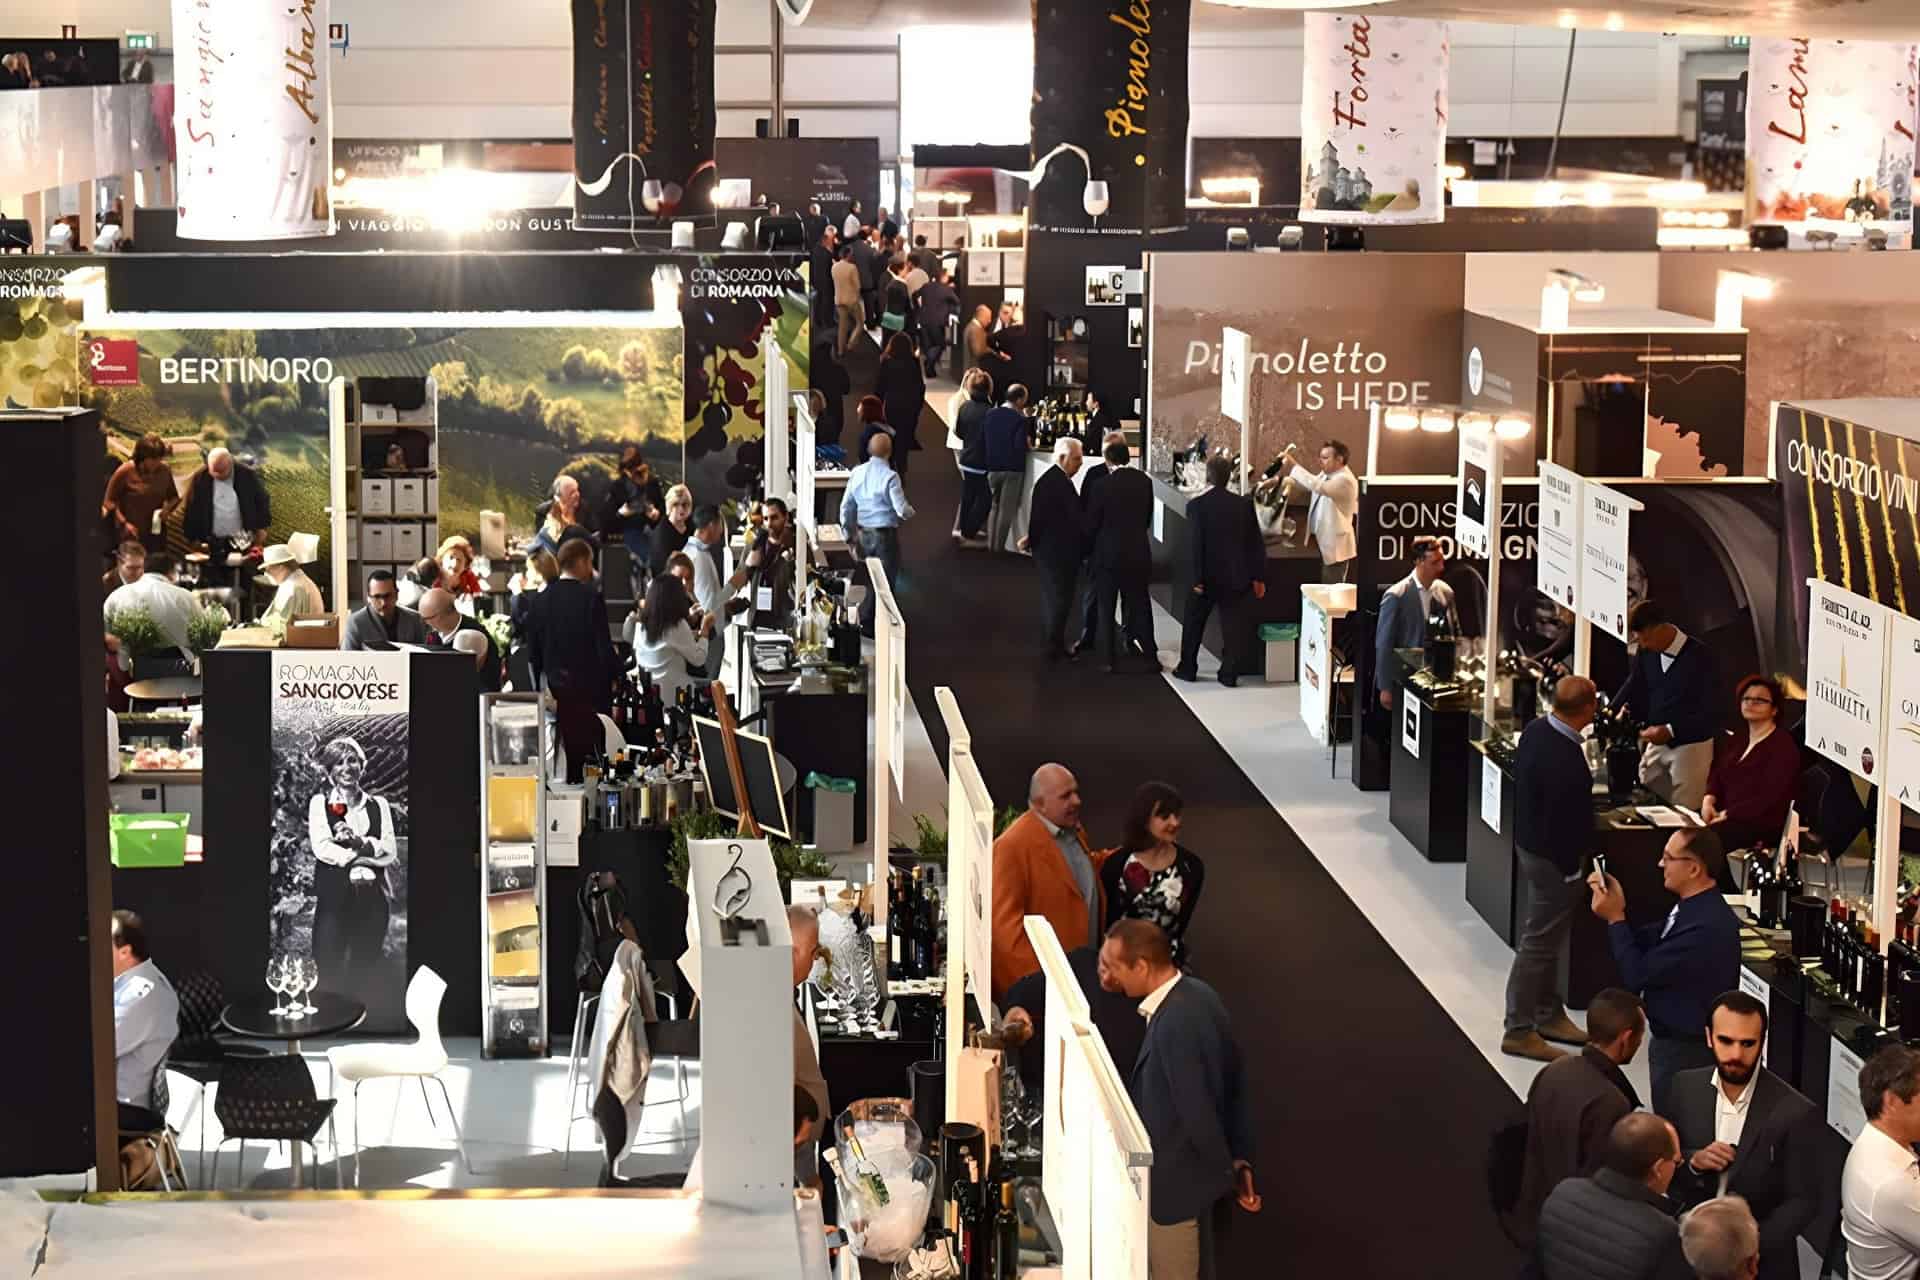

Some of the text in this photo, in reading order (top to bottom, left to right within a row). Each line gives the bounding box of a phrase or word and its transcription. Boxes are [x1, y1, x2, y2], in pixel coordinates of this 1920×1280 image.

[708, 284, 785, 298] ROMAGNA
[1184, 338, 1387, 374] Pinoletto
[160, 357, 333, 384] BERTINORO
[1296, 381, 1324, 410] IS
[1788, 439, 1881, 501] CONSORZIO
[1378, 502, 1539, 529] CONSZIO
[1378, 535, 1404, 561] DI
[279, 664, 379, 681] ROMAGNA
[279, 682, 400, 700] SANGIOVESE
